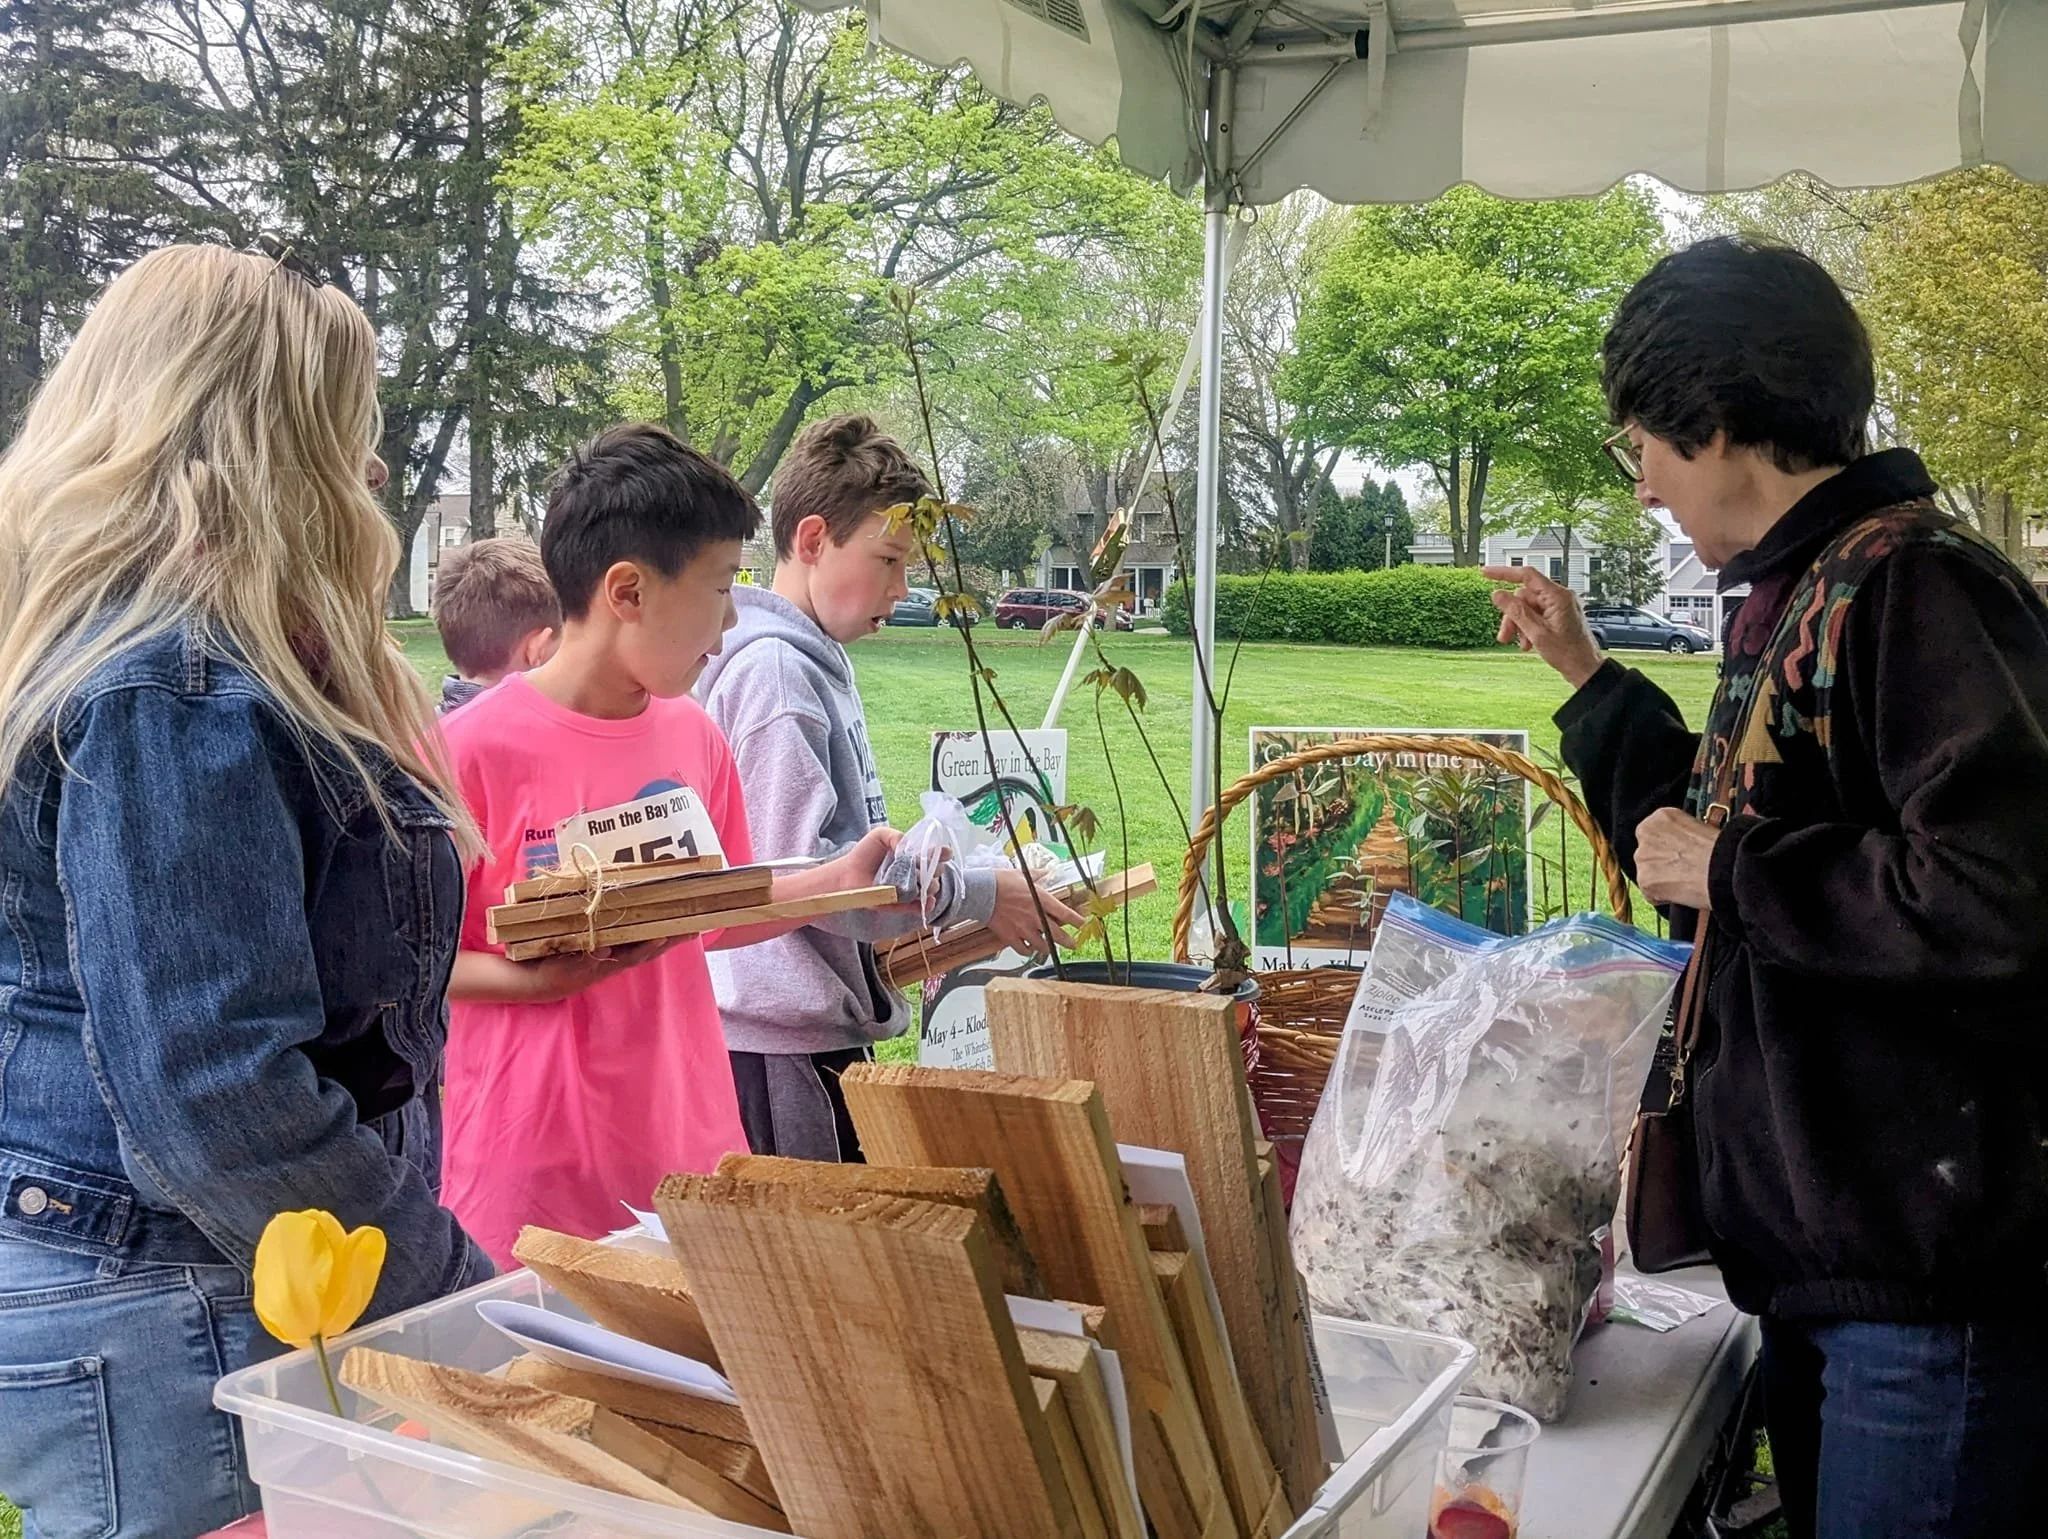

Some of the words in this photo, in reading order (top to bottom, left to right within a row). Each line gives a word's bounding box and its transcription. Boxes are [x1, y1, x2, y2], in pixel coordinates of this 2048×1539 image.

[941, 751, 979, 778] Green
[1010, 751, 1021, 773] in
[1043, 747, 1062, 778] Bay
[1395, 752, 1417, 768] in
[524, 828, 556, 842] Run
[587, 819, 616, 836] Run
[619, 810, 642, 829] the
[644, 804, 669, 821] Bay
[927, 1027, 948, 1048] May
[950, 1019, 957, 1039] 4
[966, 1012, 989, 1034] Klod
